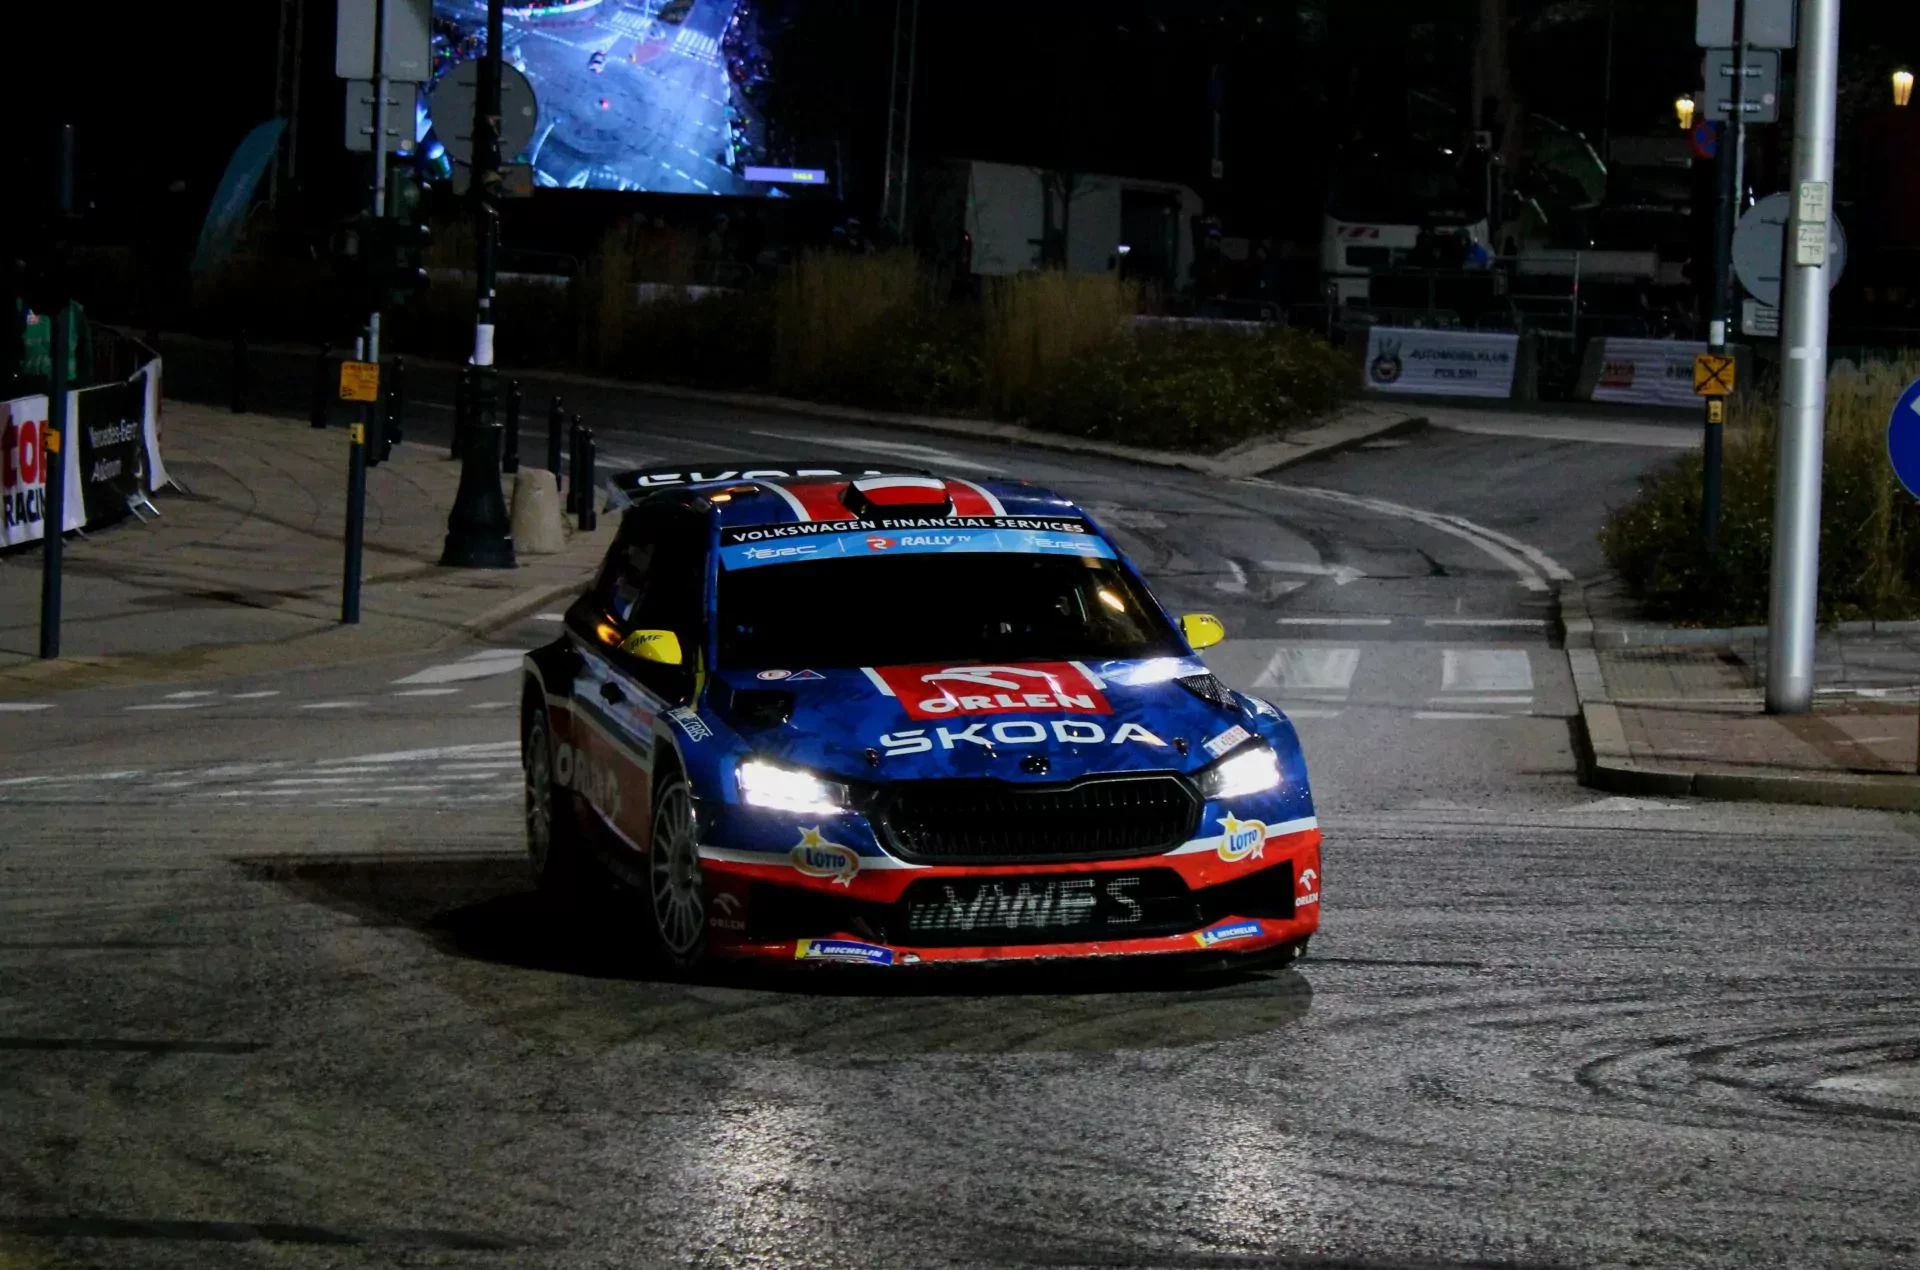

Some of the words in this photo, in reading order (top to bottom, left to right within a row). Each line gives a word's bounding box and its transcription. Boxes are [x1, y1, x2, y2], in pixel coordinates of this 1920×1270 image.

[732, 520, 876, 542] VOLKSWAGEN
[882, 517, 991, 529] FINANCIAL
[994, 518, 1085, 534] SERVICES
[901, 535, 953, 547] RALLY
[957, 535, 972, 543] TV
[918, 694, 1096, 713] ORLEN
[1229, 829, 1258, 852] LOTTO
[805, 847, 846, 868] LOTTO
[1295, 892, 1319, 907] ORLEN
[708, 917, 746, 931] ORLEN
[1217, 925, 1258, 938] MICHELIN
[823, 945, 883, 958] MICHELIN
